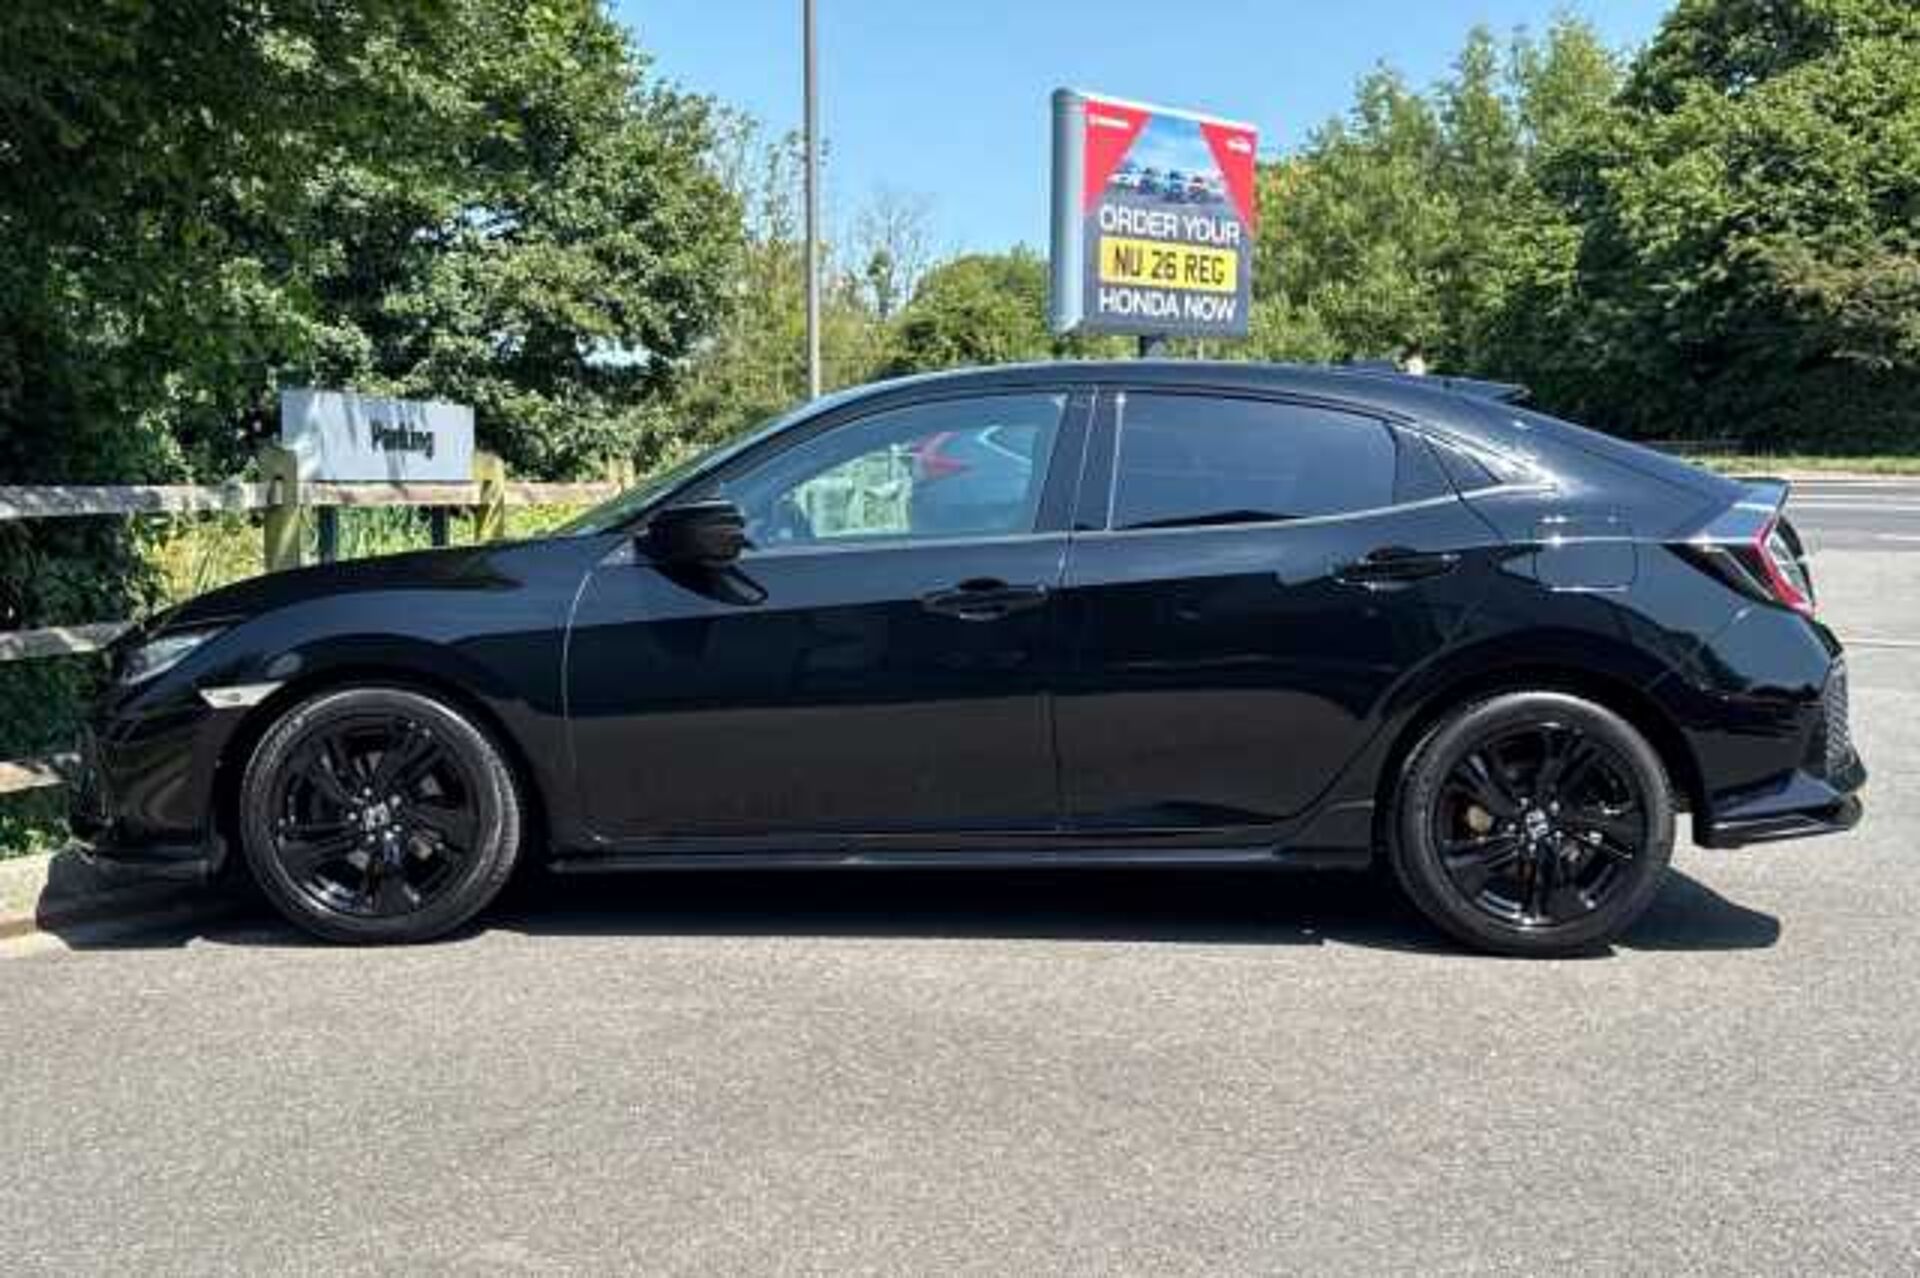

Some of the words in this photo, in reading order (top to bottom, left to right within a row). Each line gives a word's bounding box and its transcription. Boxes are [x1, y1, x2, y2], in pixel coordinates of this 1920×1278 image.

[1100, 203, 1177, 239] ORDER
[1183, 215, 1240, 244] YOUR
[1151, 252, 1176, 280] 26
[1184, 254, 1225, 285] REG
[1100, 287, 1179, 317] HONDA
[1184, 296, 1237, 322] NOW
